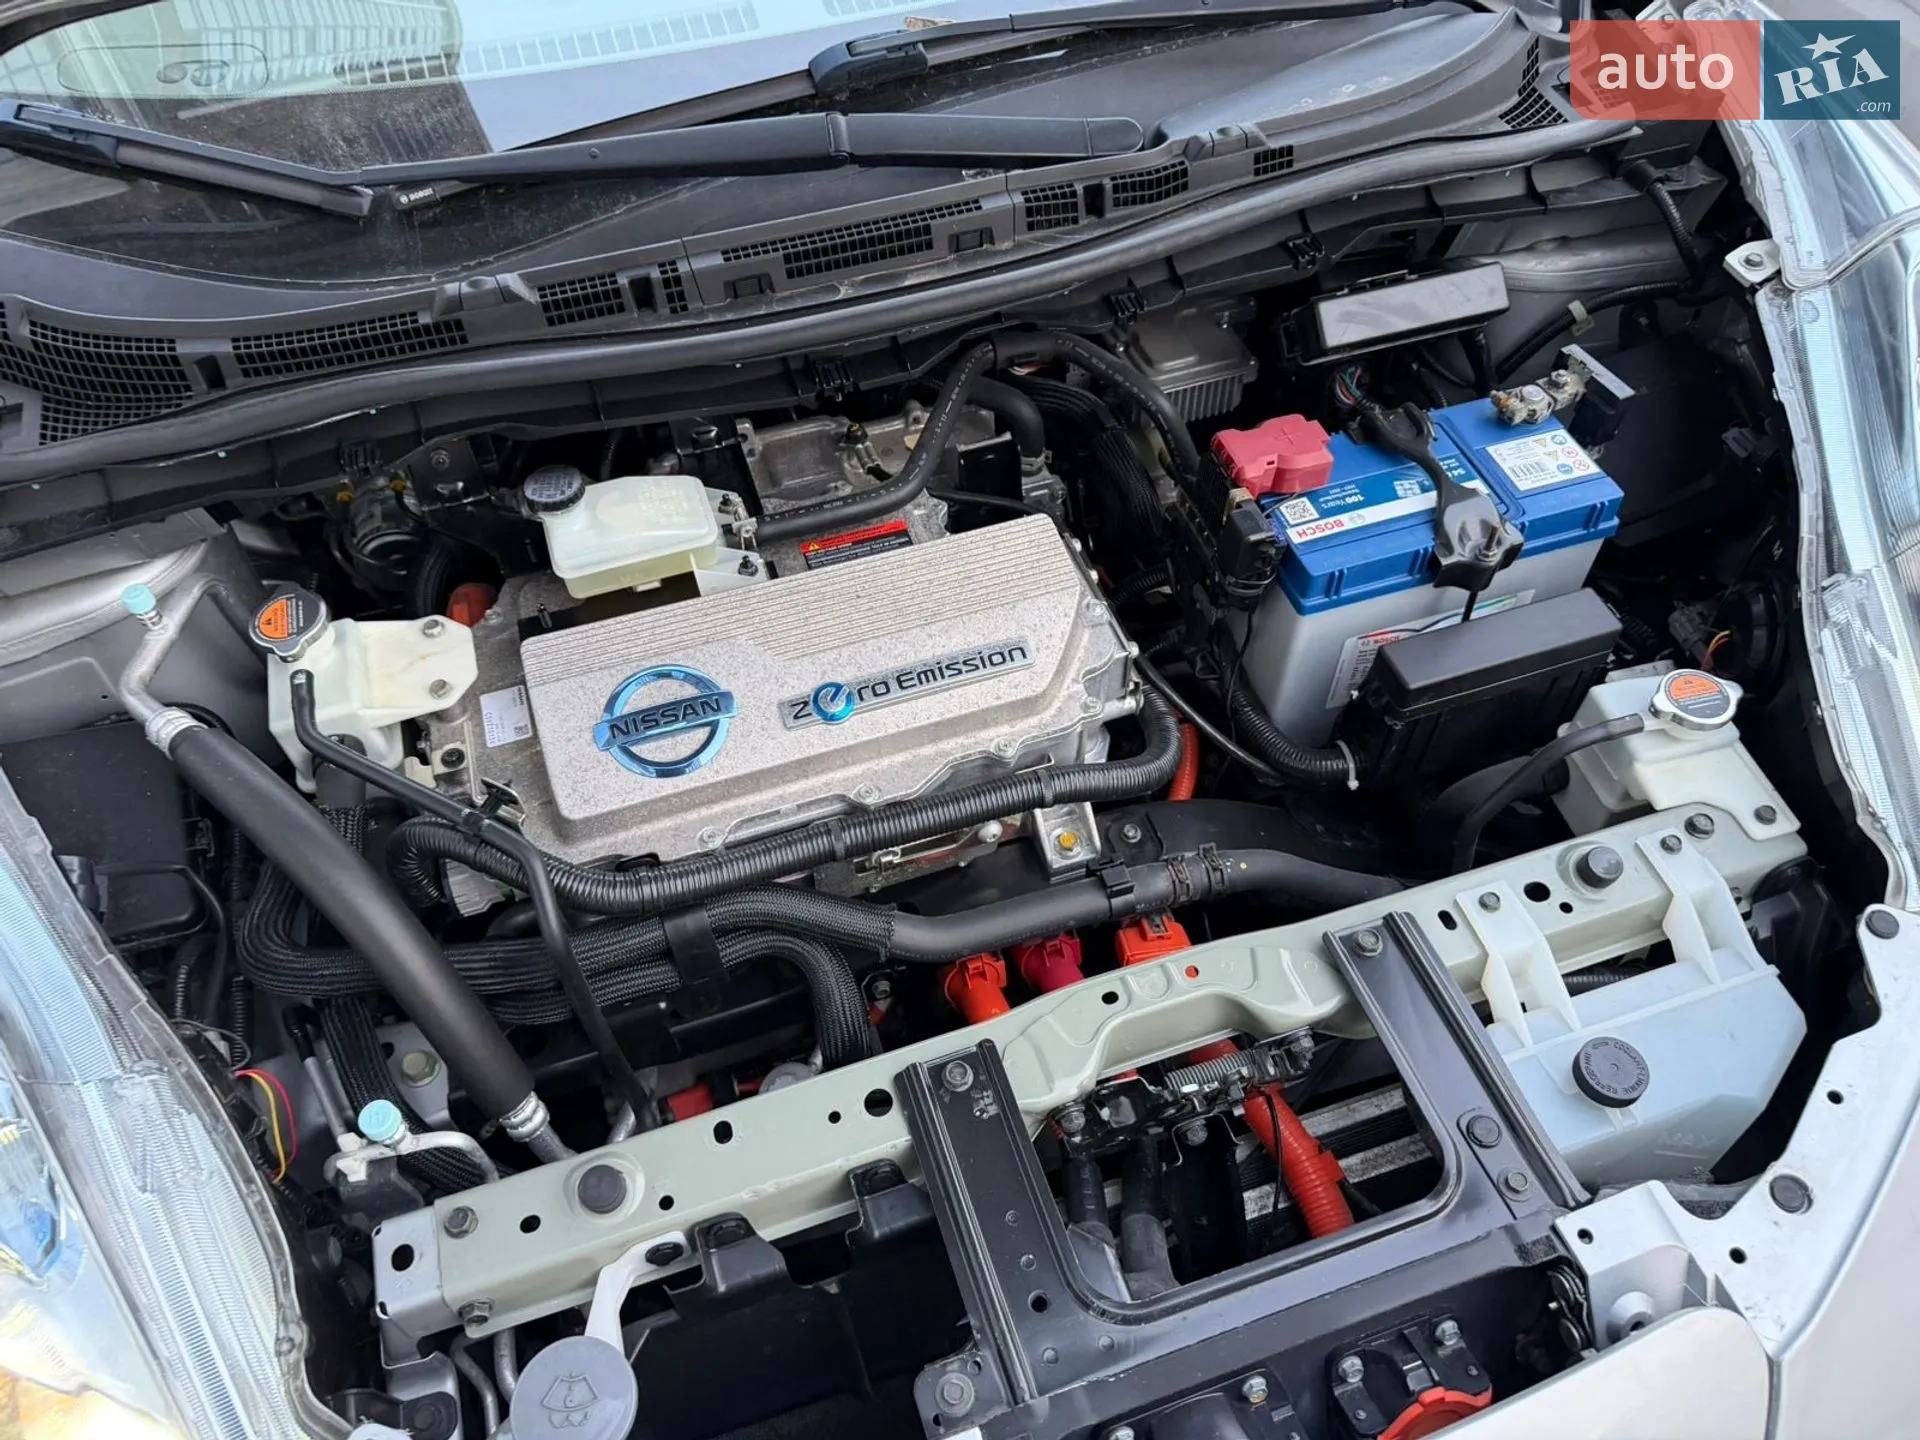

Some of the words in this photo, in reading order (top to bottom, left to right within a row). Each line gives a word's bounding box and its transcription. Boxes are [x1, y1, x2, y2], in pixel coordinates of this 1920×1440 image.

[1296, 519, 1345, 539] BOSCH
[896, 643, 1029, 692] Emission
[609, 696, 721, 740] NISSAN
